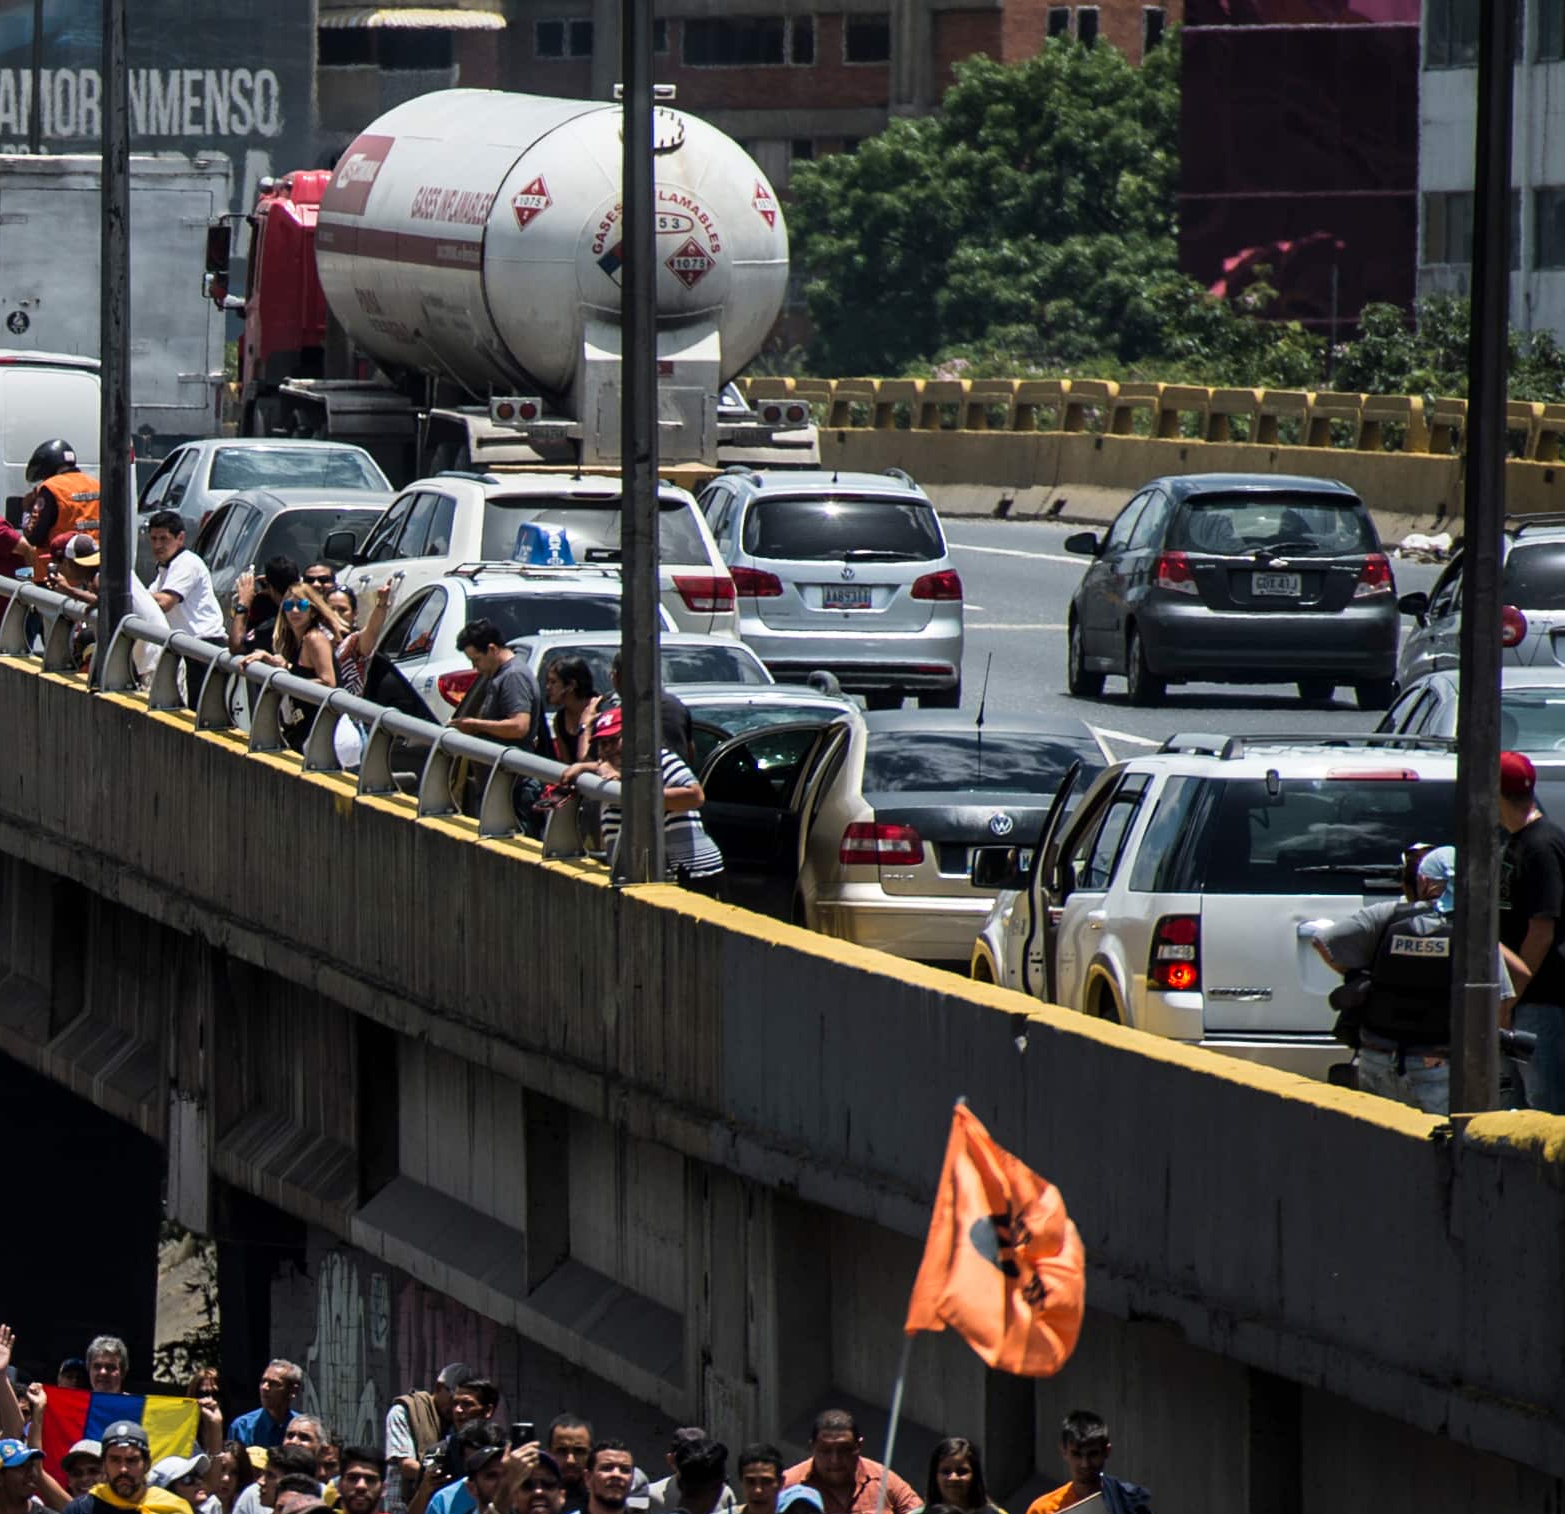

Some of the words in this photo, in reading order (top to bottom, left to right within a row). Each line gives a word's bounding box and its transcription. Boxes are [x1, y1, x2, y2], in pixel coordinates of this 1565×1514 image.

[127, 68, 284, 137] NMENSO
[411, 186, 443, 220] GASES
[435, 189, 496, 226] INFLAMABLES
[518, 197, 541, 207] 1075
[656, 190, 732, 254] LAMABLES
[592, 203, 624, 255] GASES
[675, 257, 706, 269] 1075
[1395, 938, 1445, 954] PRESS
